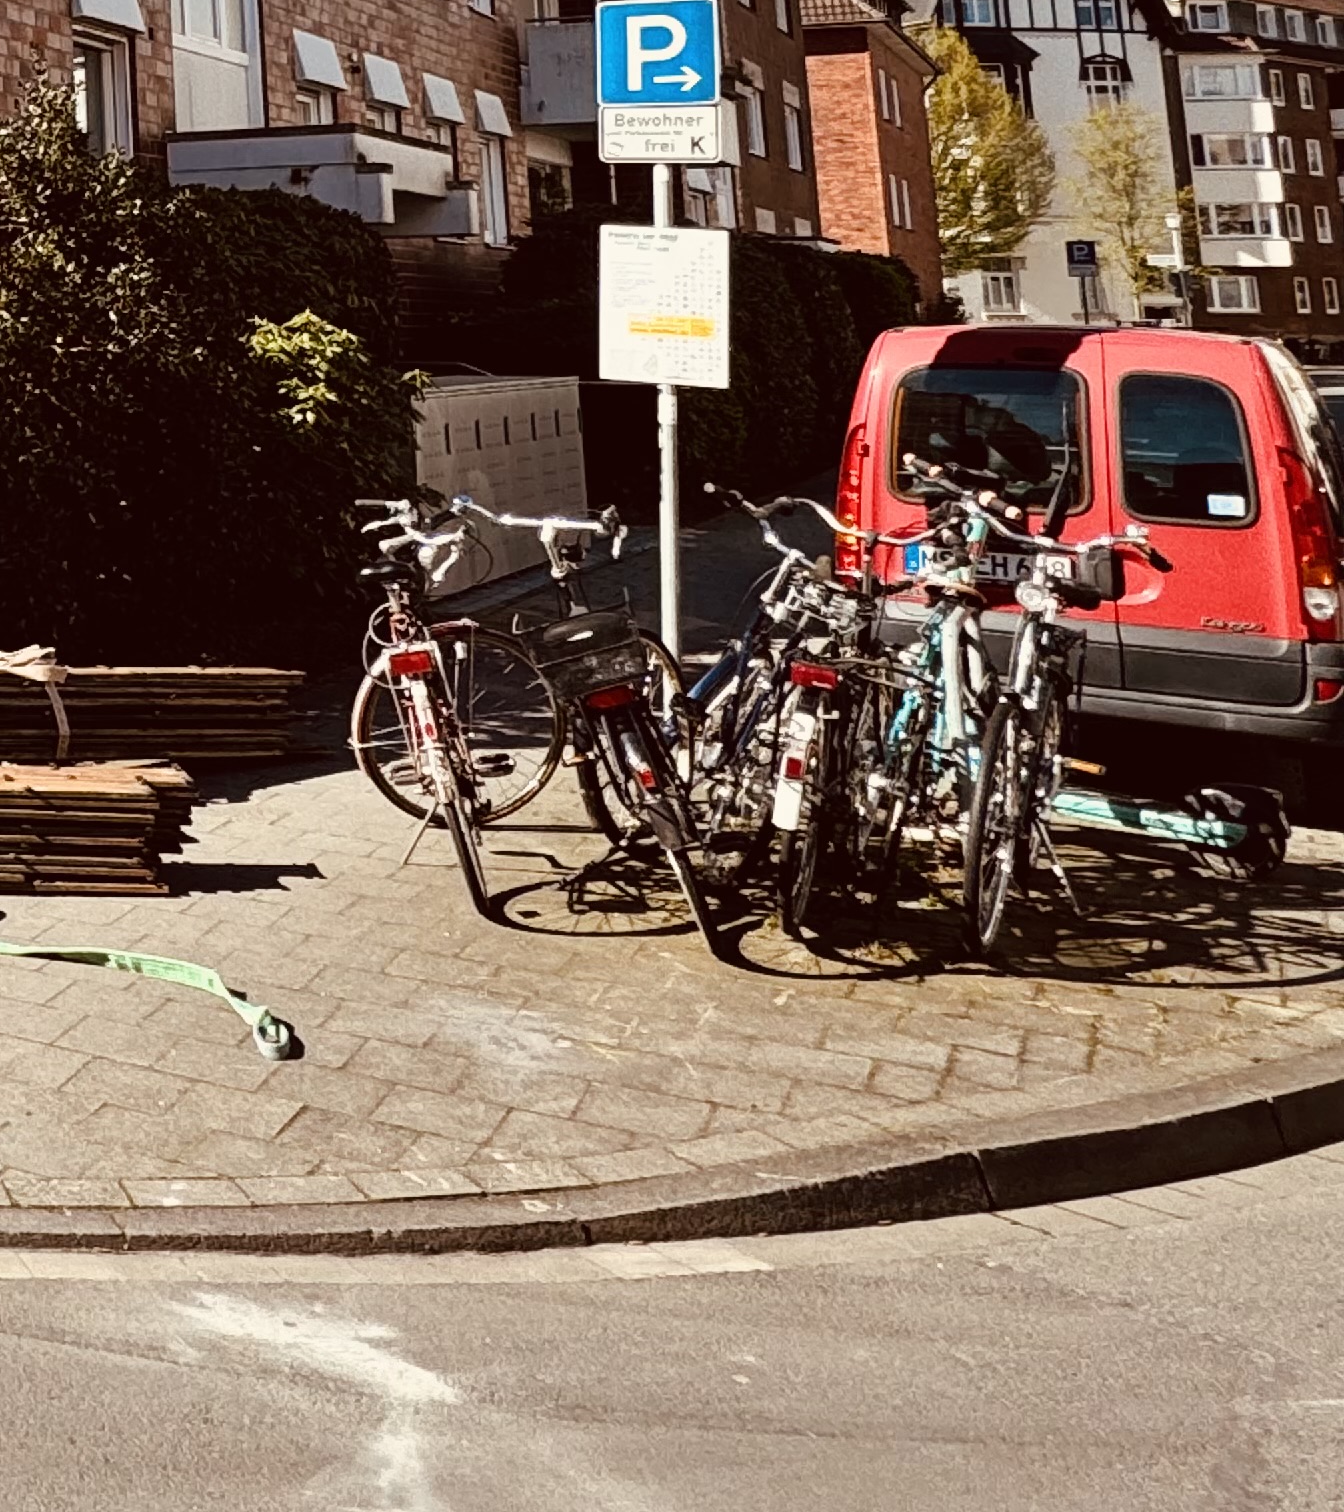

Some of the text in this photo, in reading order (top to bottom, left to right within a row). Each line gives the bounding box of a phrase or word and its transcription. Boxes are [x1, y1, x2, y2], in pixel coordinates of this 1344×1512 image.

[626, 14, 687, 92] P
[614, 112, 704, 128] Bewohner
[644, 135, 706, 155] frei K
[1072, 244, 1089, 262] P
